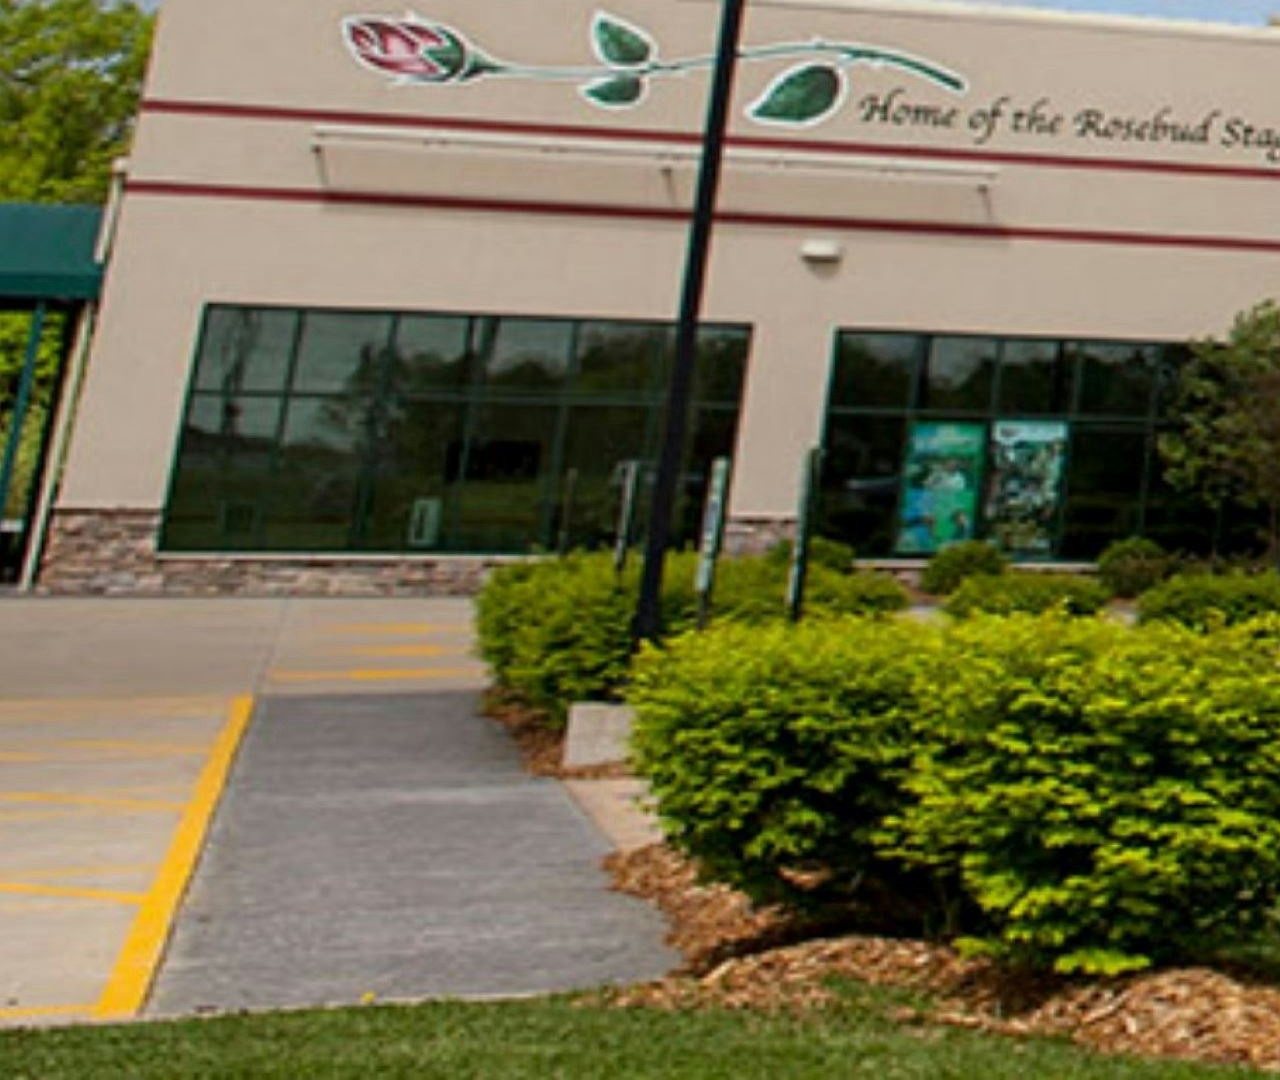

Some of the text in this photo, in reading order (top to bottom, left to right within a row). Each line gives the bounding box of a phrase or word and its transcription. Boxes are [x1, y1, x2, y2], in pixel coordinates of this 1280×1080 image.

[860, 89, 958, 127] Home
[968, 97, 1010, 145] of
[1011, 98, 1063, 134] the
[1073, 106, 1221, 143] Rosebud
